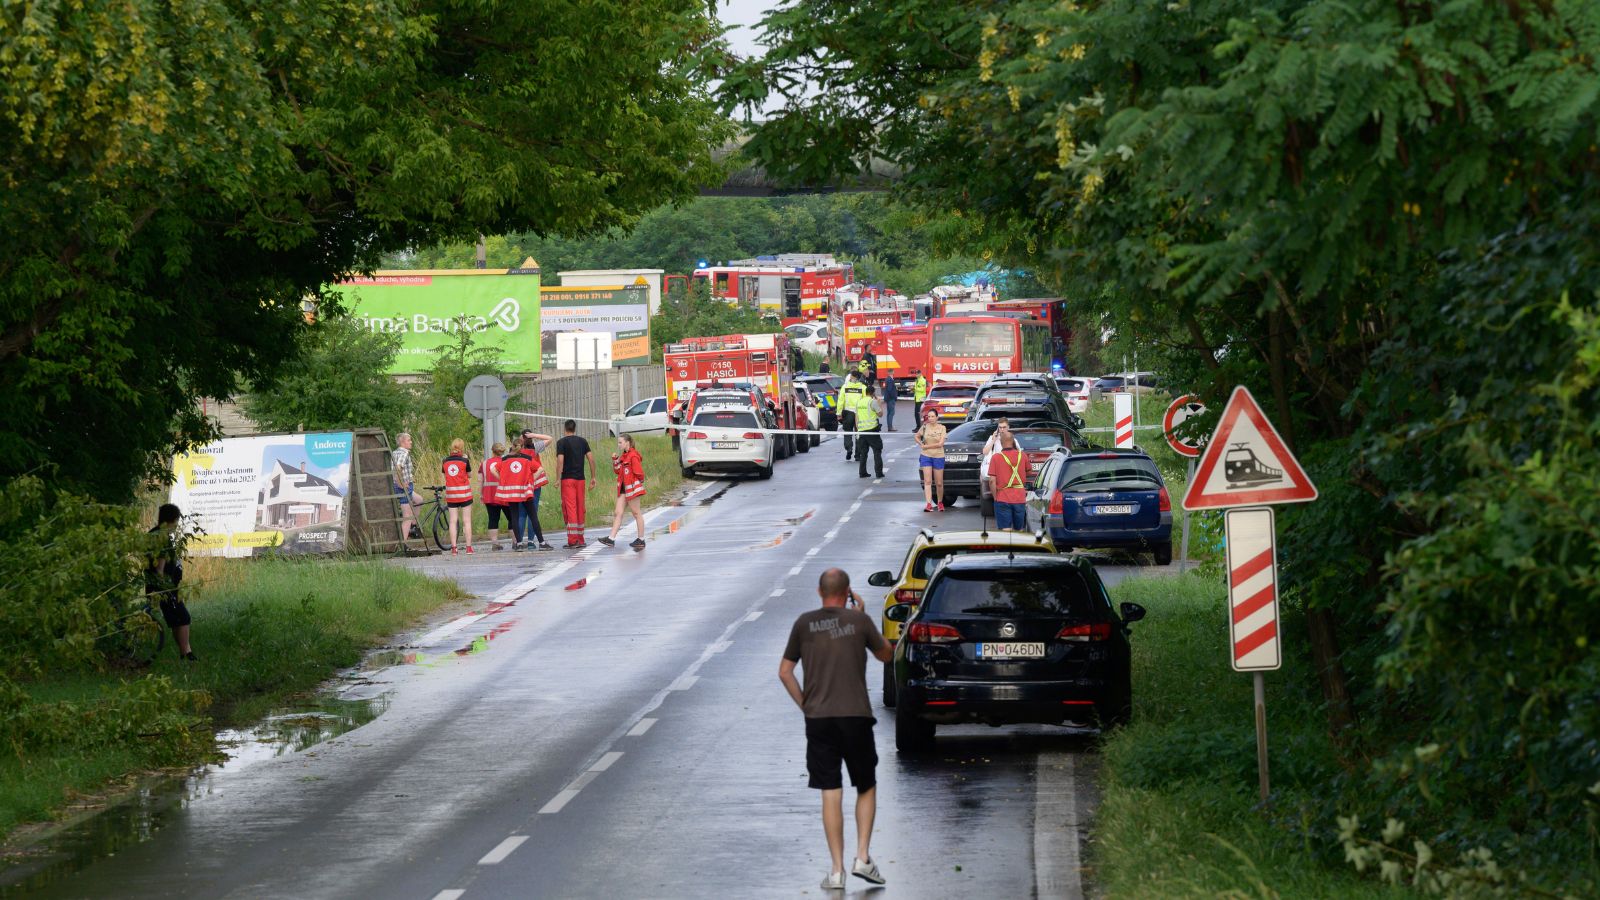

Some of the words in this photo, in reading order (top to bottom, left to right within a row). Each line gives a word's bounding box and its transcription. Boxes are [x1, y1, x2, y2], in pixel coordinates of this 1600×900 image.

[413, 313, 489, 334] Banka
[866, 317, 893, 325] HASIČI
[900, 339, 922, 348] HASIČI
[717, 361, 731, 369] 150
[953, 361, 993, 371] HASIČI
[706, 368, 737, 379] HASIČI
[298, 531, 328, 540] PROSPECT
